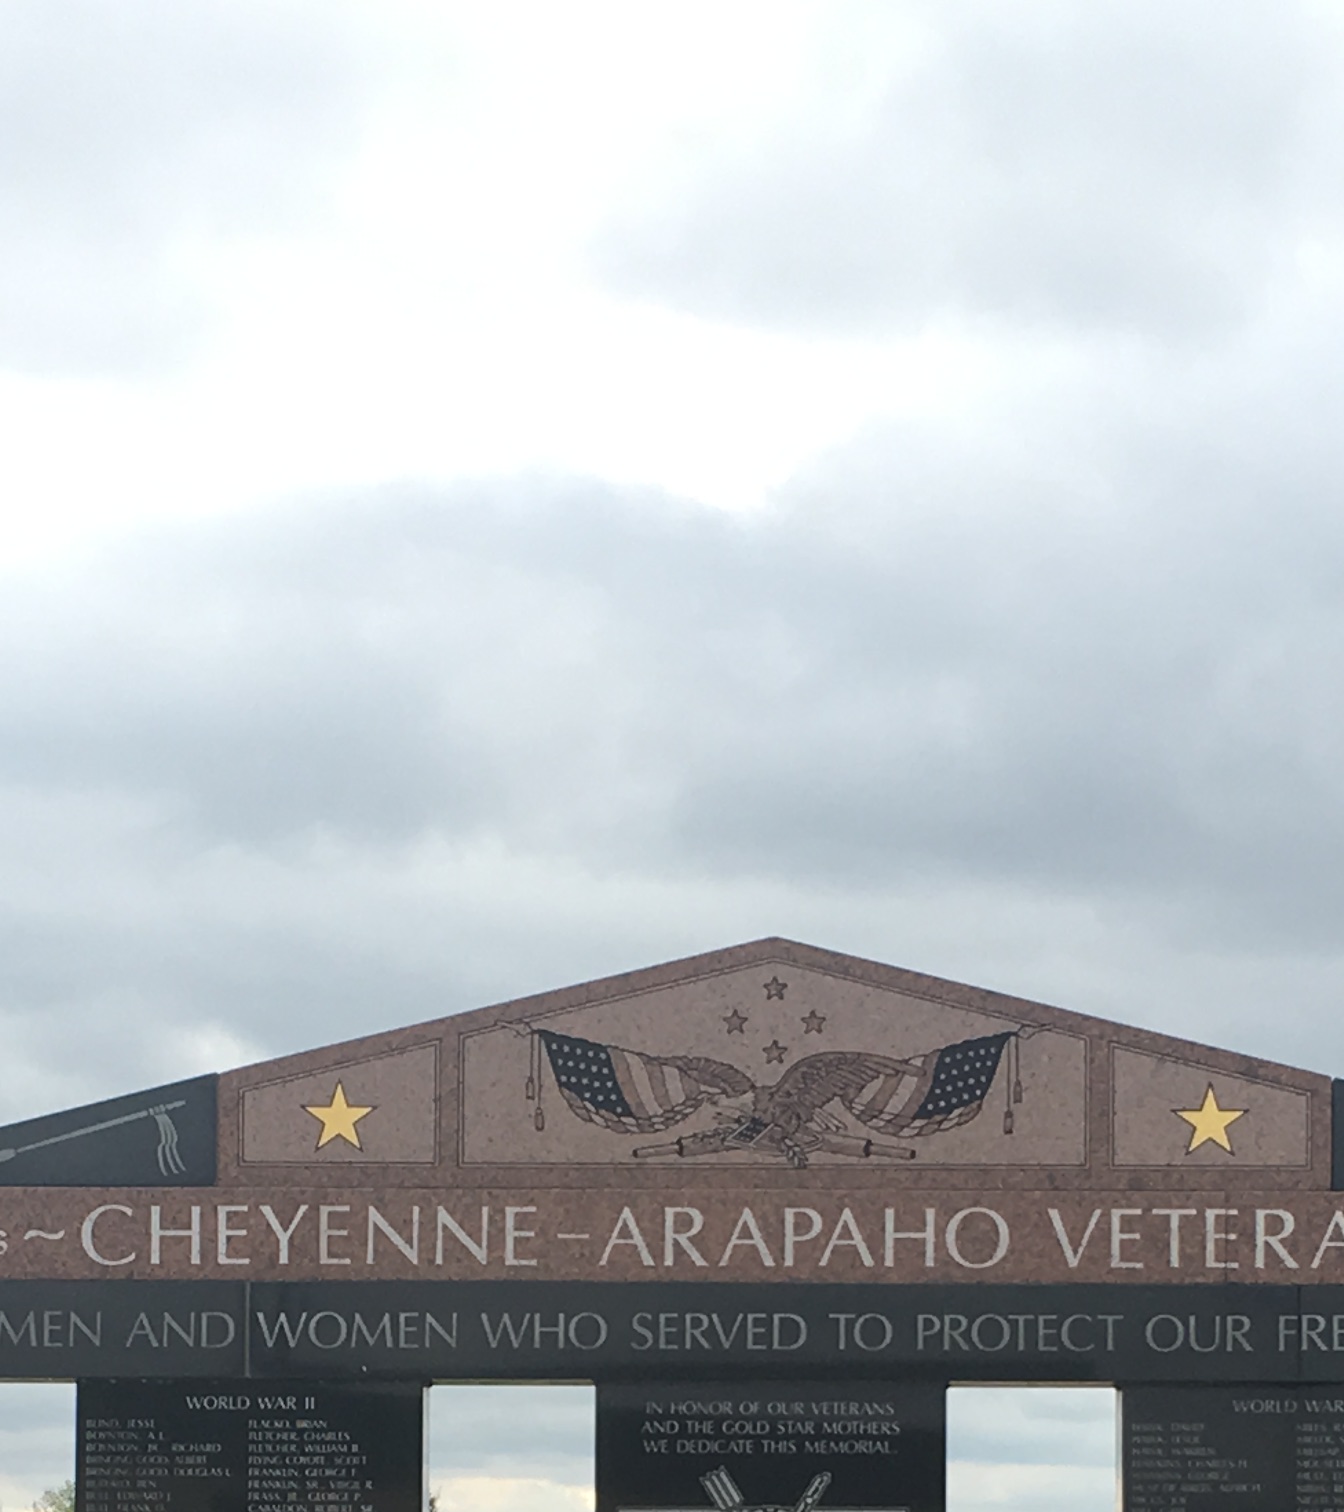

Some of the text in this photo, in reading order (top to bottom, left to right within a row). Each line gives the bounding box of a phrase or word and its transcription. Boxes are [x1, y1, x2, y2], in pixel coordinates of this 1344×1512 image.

[125, 1311, 236, 1349] AND
[256, 1311, 457, 1350] WOMEN
[479, 1311, 609, 1350] WHO
[630, 1312, 808, 1351] SERVED
[829, 1312, 893, 1352] TO
[916, 1313, 1124, 1353] PROTECT
[1145, 1313, 1253, 1353] OUR
[186, 1396, 316, 1410] WORLD WAR II
[646, 1401, 895, 1416] IN HONOR OF OUR VETERANS
[1232, 1399, 1298, 1414] WORLD
[641, 1420, 901, 1434] AND THE GOLD STAR MOTHERS
[642, 1439, 898, 1454] WE DEDICATE THIS MEMORIAL.
